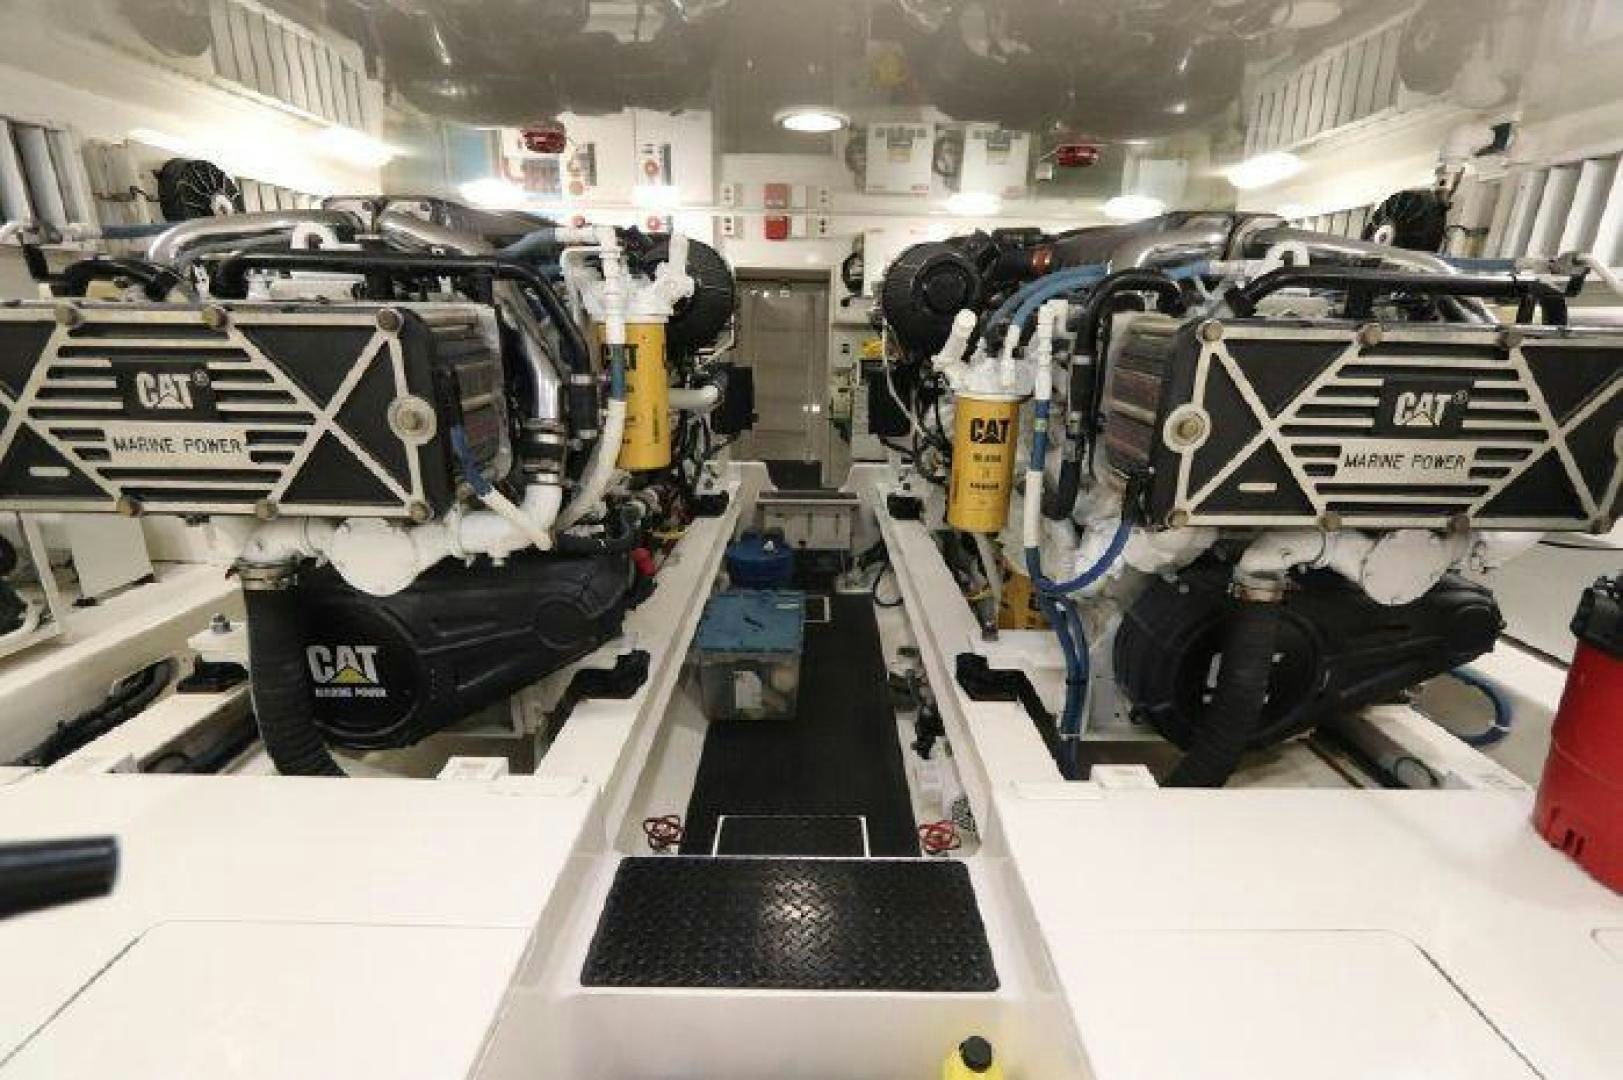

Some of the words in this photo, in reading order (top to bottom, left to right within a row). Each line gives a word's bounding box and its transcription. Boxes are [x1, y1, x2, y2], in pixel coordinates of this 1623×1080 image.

[970, 417, 1010, 444] CAT
[113, 437, 176, 453] MARINE
[183, 438, 241, 453] POWER
[1343, 453, 1405, 469] MARINE
[1411, 454, 1466, 469] POWER
[306, 645, 379, 684] CAT
